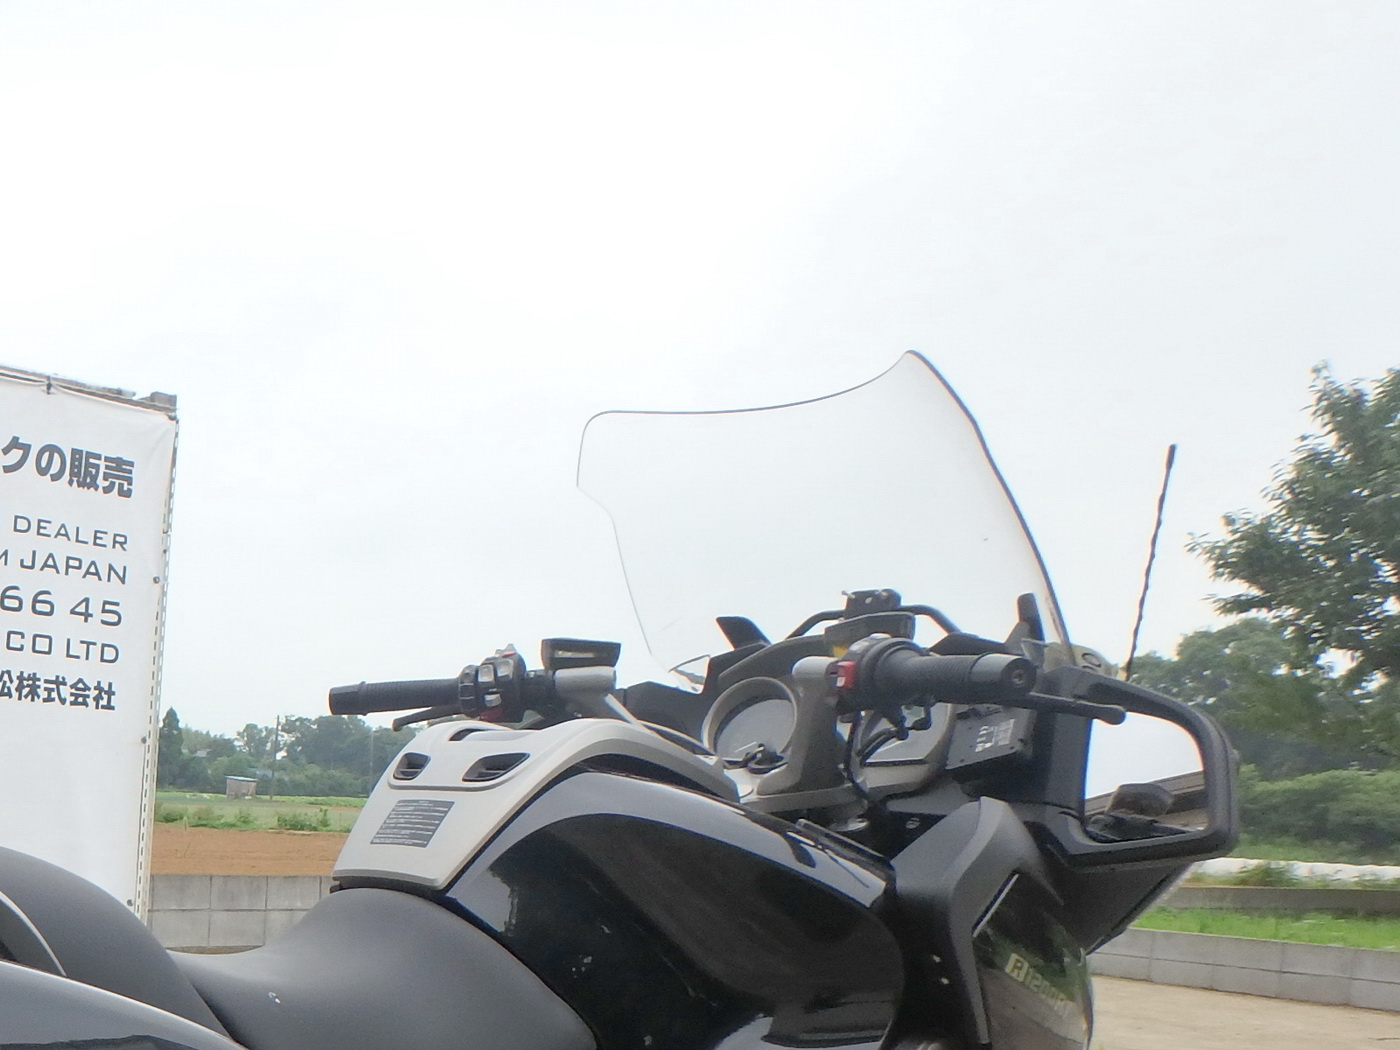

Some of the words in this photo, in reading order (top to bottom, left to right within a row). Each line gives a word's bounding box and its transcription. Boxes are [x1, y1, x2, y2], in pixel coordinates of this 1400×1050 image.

[13, 515, 128, 551] DEALER
[20, 550, 127, 585] JAPAN
[69, 597, 122, 632] 45
[5, 630, 53, 656] CO
[65, 638, 119, 664] LTD
